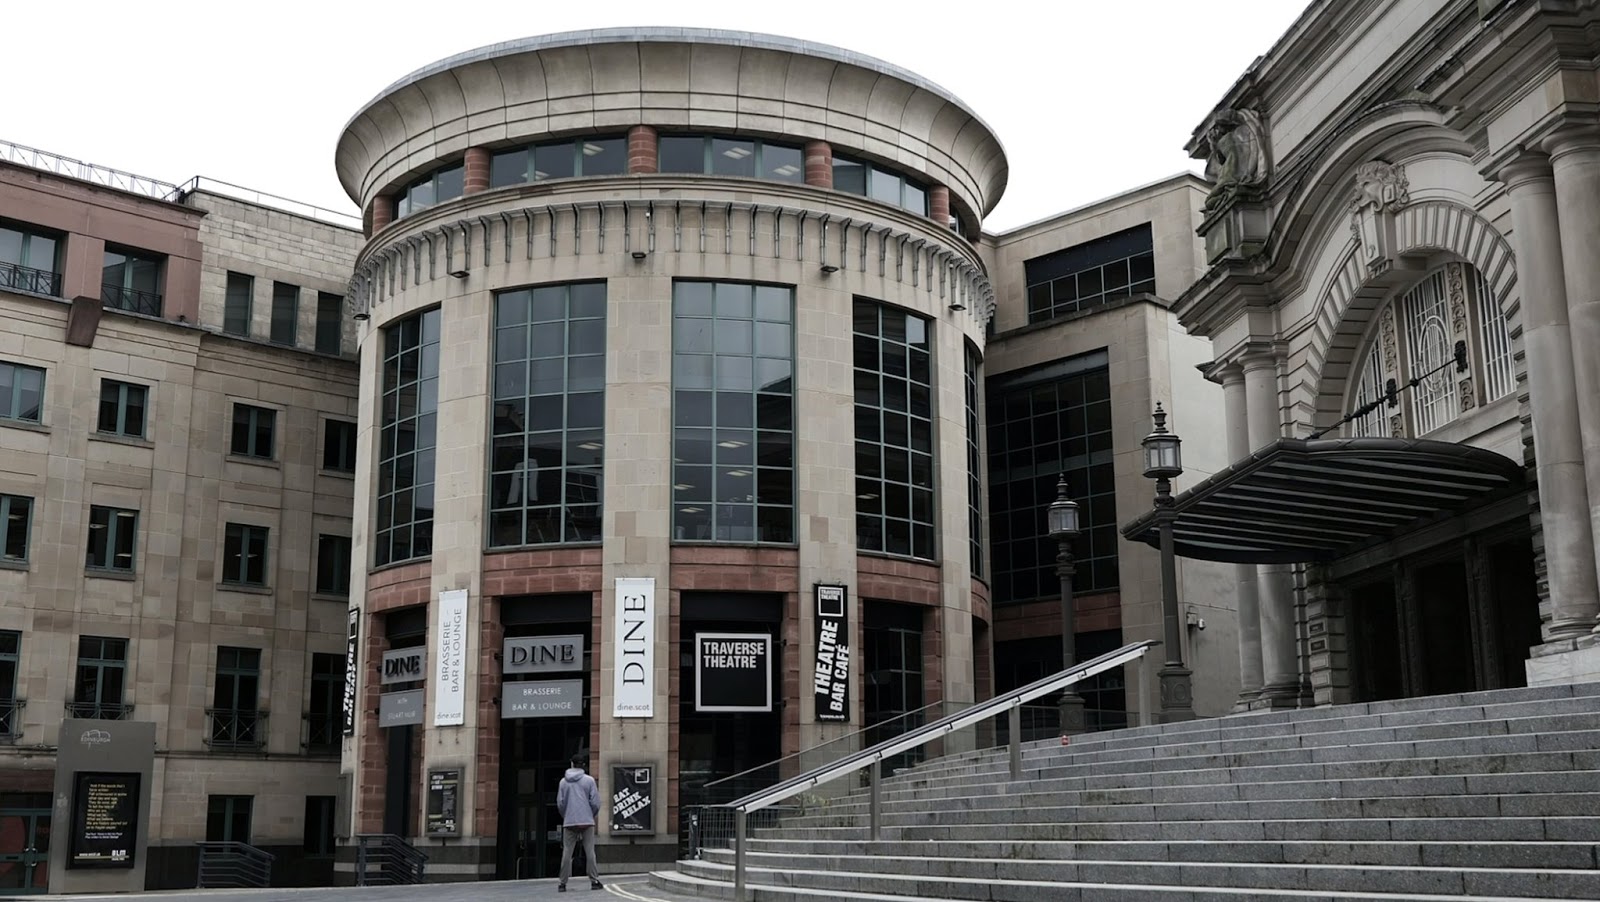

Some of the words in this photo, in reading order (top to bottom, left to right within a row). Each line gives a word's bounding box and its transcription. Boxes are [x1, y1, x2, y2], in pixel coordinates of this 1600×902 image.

[453, 608, 462, 657] LOUNGE
[622, 594, 646, 686] DINE
[441, 621, 451, 681] BRASSERIE
[510, 644, 575, 665] DINE
[703, 642, 765, 655] TRAVERSE
[814, 619, 839, 695] THEATRE
[385, 655, 421, 677] DINE
[452, 659, 460, 667] &
[703, 655, 757, 668] THEATRE
[834, 644, 850, 680] CAFÉ
[451, 672, 460, 693] BAR
[523, 687, 562, 696] BRASSERIE
[512, 703, 528, 711] BAR
[530, 703, 536, 711] &
[538, 701, 573, 710] LOUNGE
[617, 702, 650, 711] dine.scot
[829, 681, 846, 712] BAR
[436, 711, 462, 720] dine.scot
[613, 787, 630, 803] EAT
[613, 791, 642, 815] DRINK
[621, 795, 651, 819] RELAX
